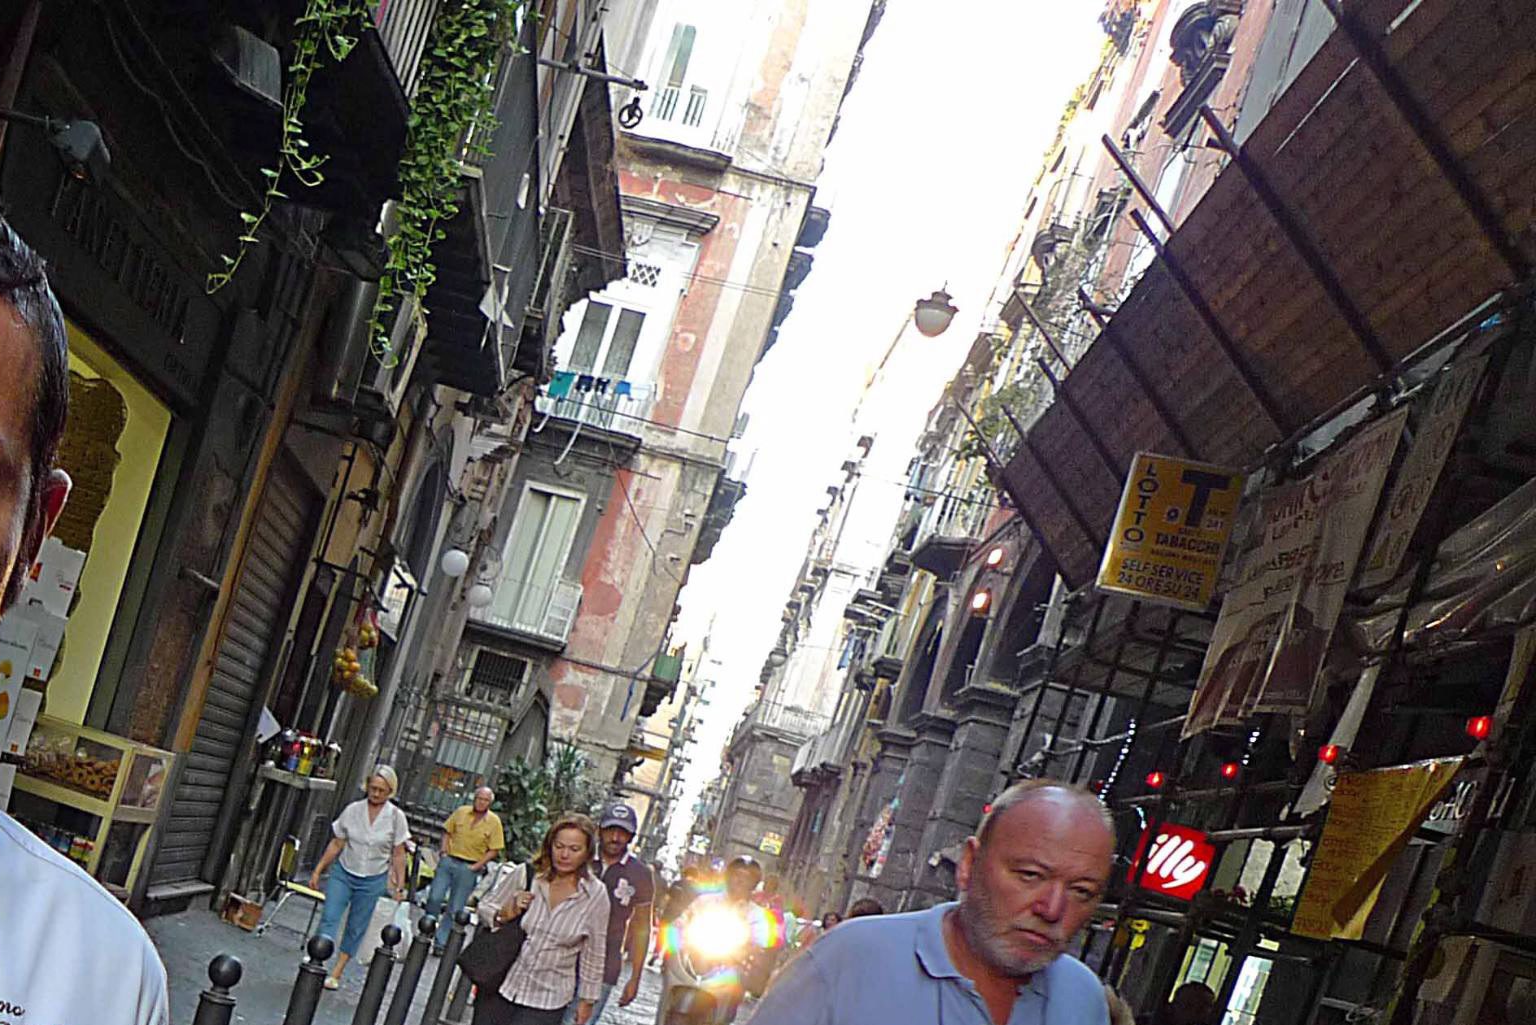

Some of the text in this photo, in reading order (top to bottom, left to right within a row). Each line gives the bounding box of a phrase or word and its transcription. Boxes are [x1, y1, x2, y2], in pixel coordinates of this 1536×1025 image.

[1124, 464, 1159, 542] LOTTO
[1181, 470, 1230, 526] T
[1146, 833, 1206, 889] illy
